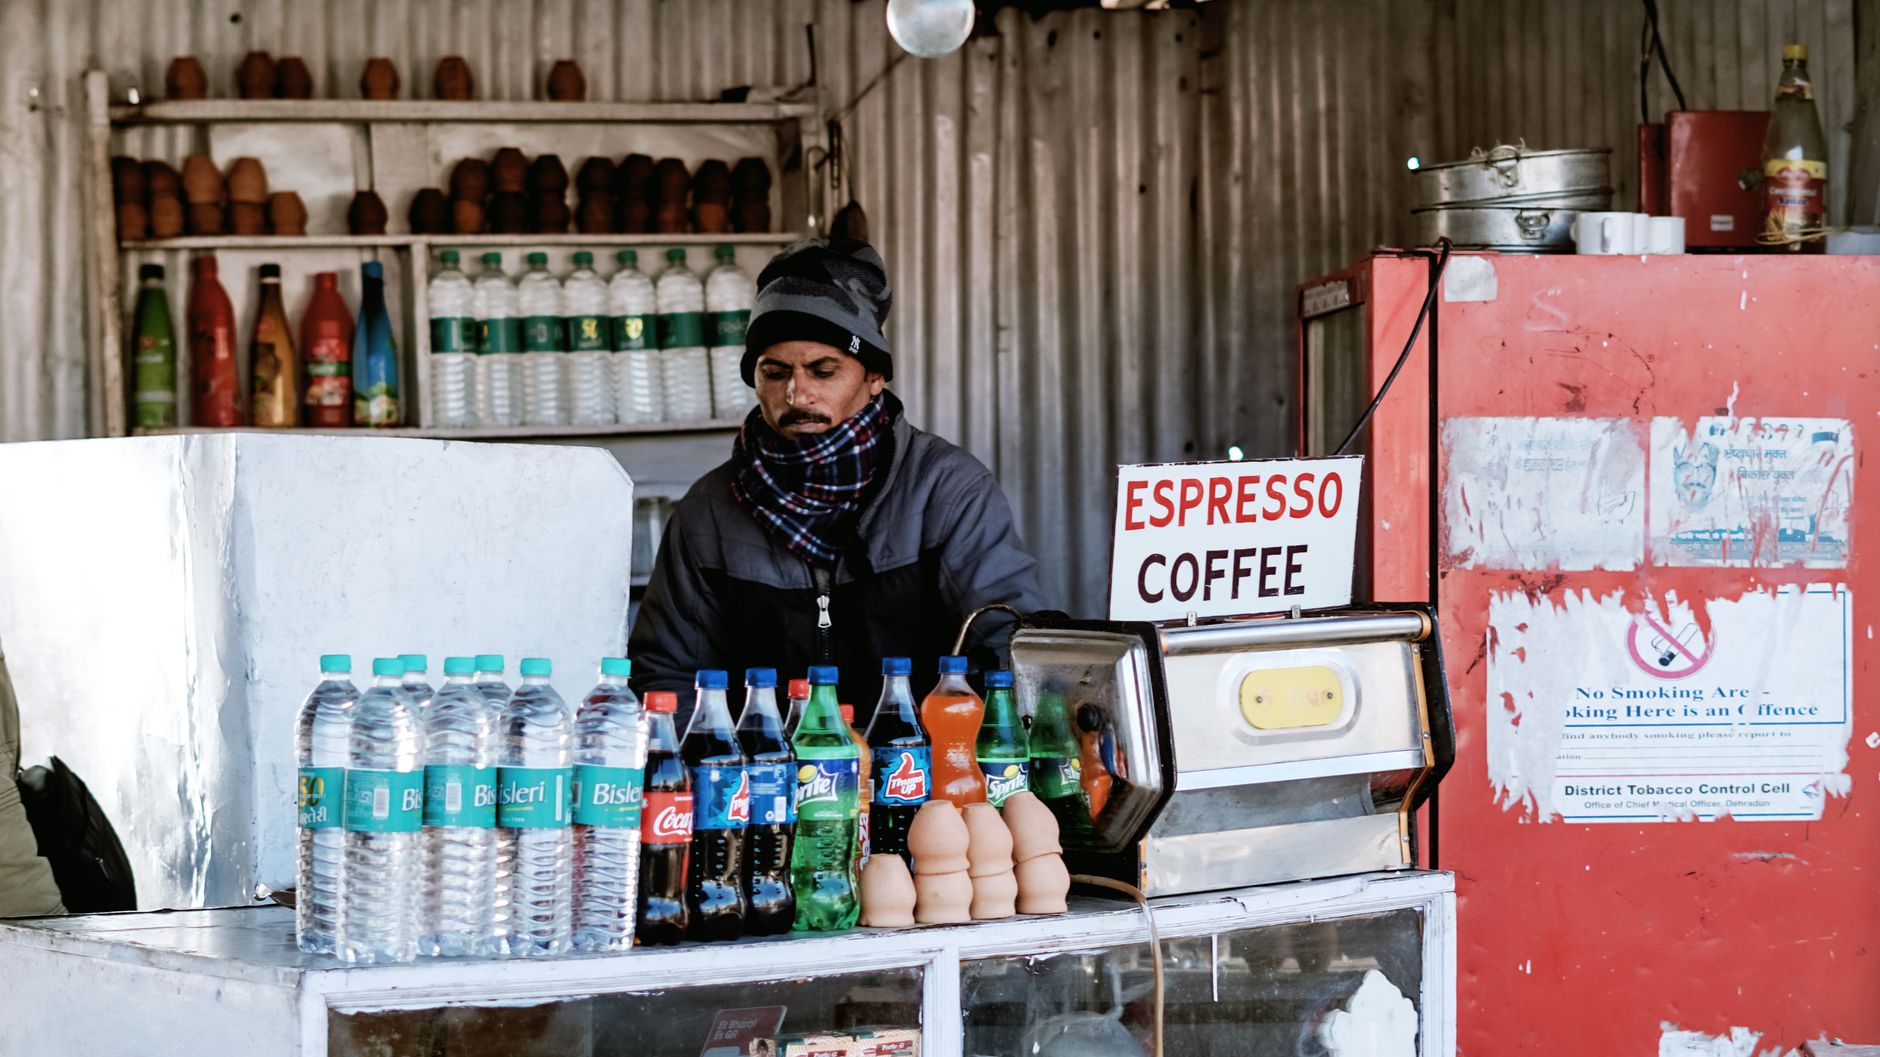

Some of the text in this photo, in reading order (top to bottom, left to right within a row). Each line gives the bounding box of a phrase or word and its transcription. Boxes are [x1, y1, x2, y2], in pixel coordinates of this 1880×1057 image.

[1125, 472, 1343, 530] ESPRESSO
[1137, 544, 1308, 604] COFFEE
[1576, 687, 1604, 699] No
[1612, 687, 1704, 701] Smoking
[1712, 687, 1750, 698] Are
[1626, 705, 1676, 717] Here
[1684, 705, 1698, 717] is
[1706, 706, 1729, 716] an
[1589, 732, 1638, 740] anybody
[1644, 731, 1695, 740] smoking
[1698, 731, 1734, 740] please
[1739, 730, 1775, 739] report
[986, 771, 1026, 800] Sprite
[1565, 783, 1790, 795] District Tobacco Control Cell
[1584, 801, 1611, 809] Office
[1625, 801, 1650, 809] Chief
[1652, 800, 1687, 808] Mical
[1725, 799, 1770, 807] Dehradun
